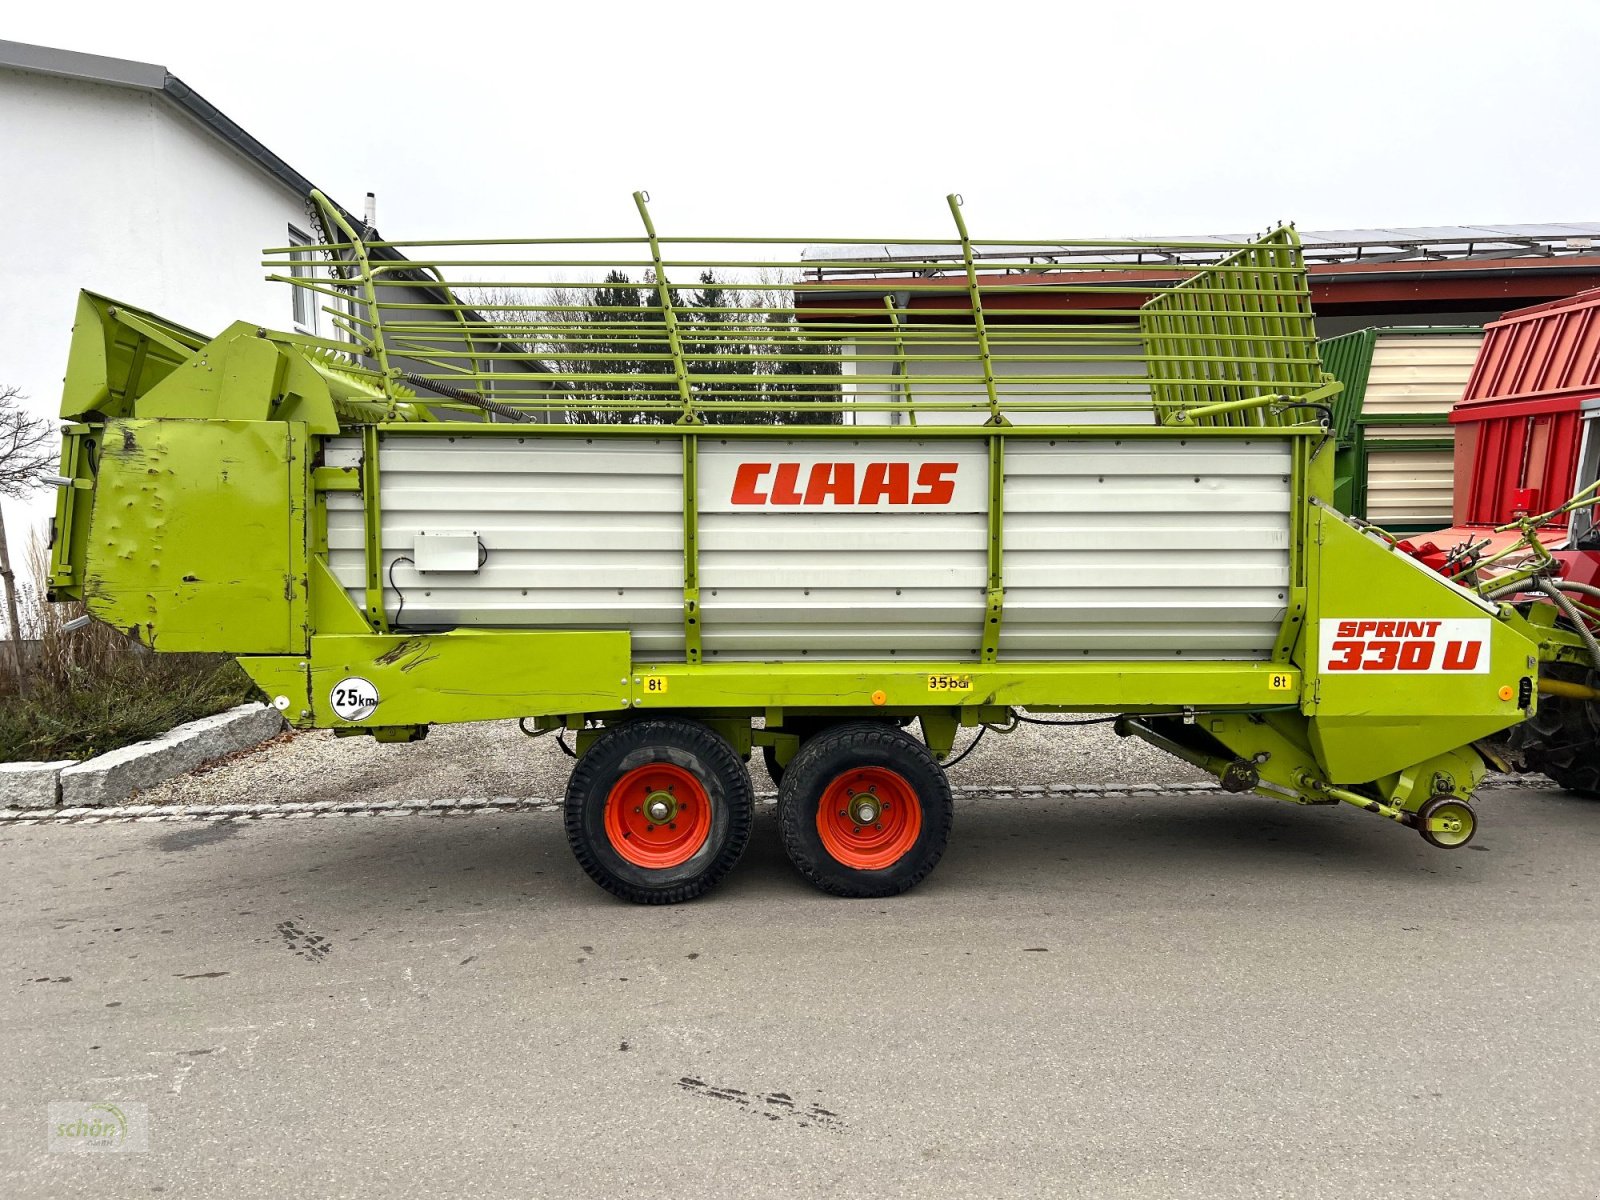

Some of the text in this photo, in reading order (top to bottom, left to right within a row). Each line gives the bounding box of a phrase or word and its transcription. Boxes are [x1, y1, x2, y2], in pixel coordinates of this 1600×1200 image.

[731, 463, 959, 505] CLAAS
[1337, 622, 1442, 637] SPRINT
[1328, 641, 1482, 670] 330 U
